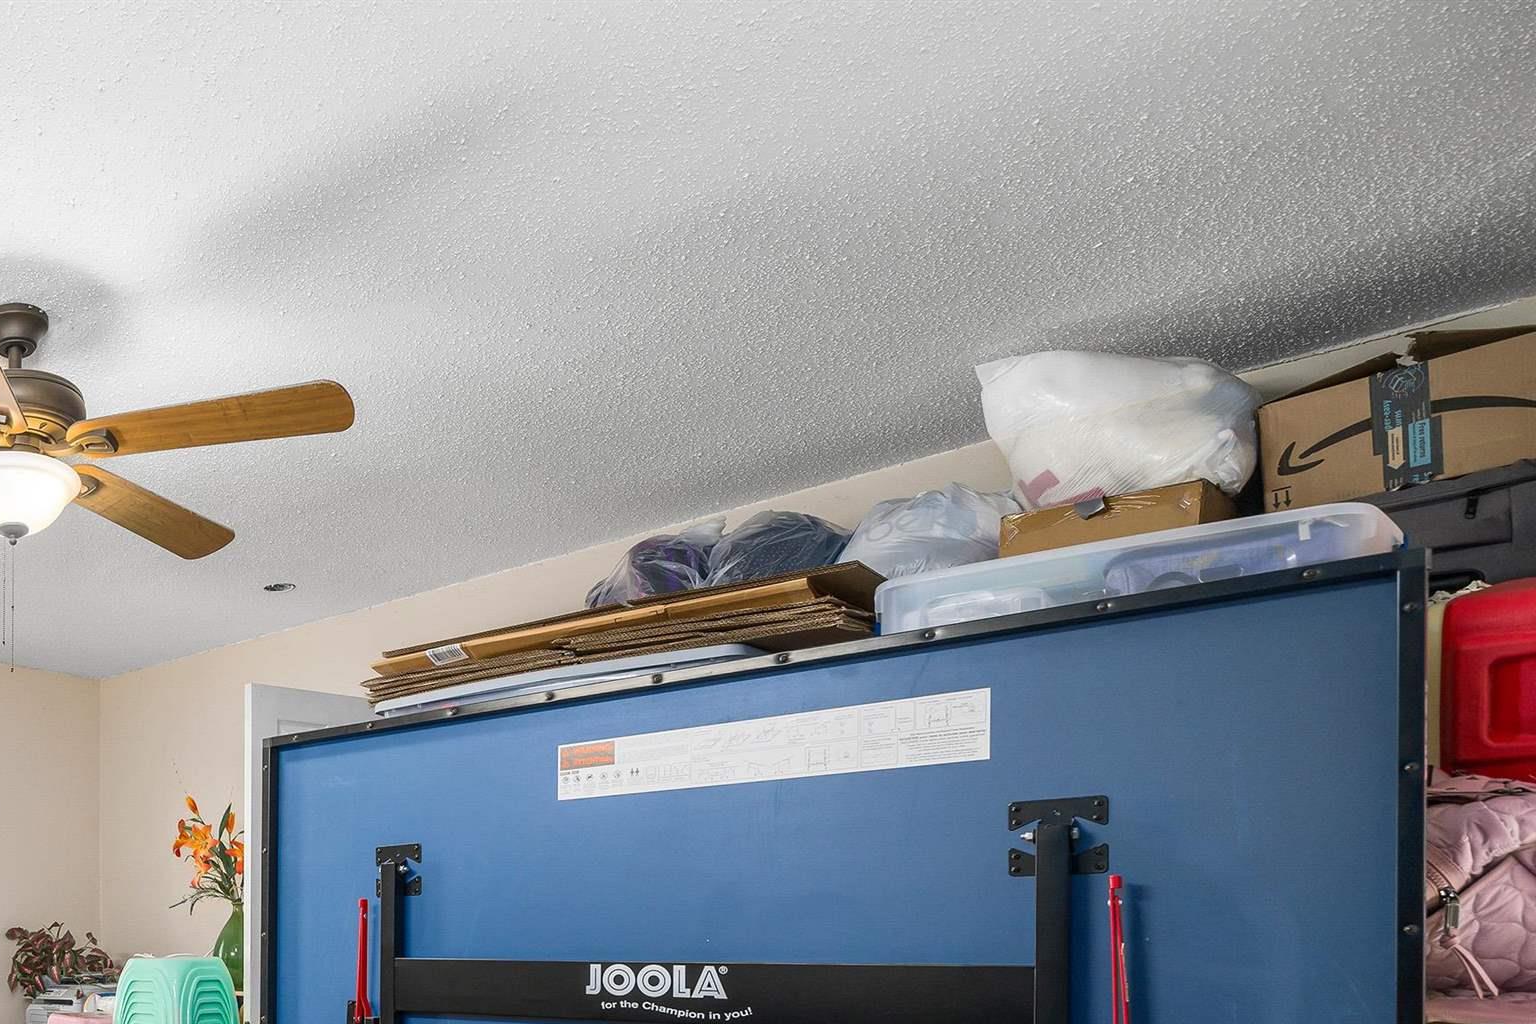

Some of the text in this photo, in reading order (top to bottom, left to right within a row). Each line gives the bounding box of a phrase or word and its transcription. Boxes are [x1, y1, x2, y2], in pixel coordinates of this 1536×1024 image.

[601, 1000, 753, 1021] for the Champion in you!
